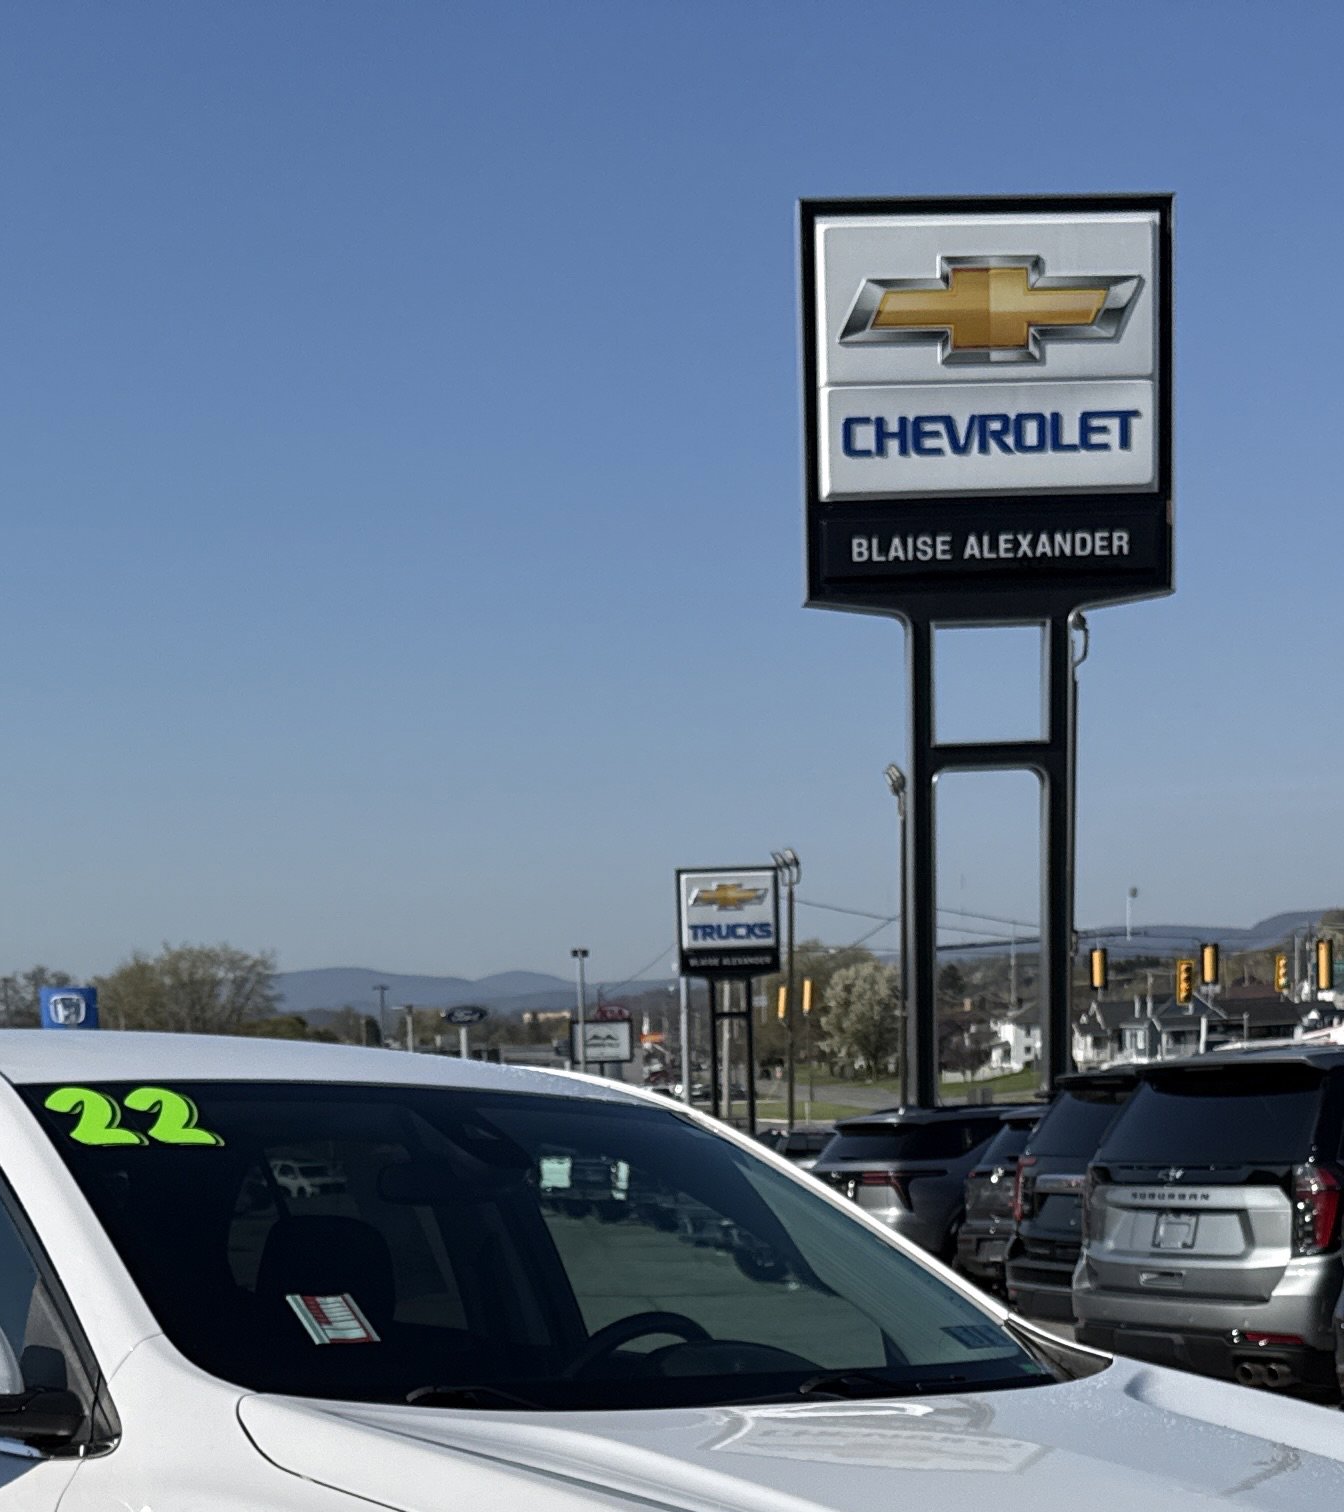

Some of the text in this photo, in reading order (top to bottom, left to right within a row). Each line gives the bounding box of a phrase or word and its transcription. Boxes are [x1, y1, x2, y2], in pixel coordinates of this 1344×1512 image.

[842, 410, 1142, 459] CHEVROLET
[852, 529, 1131, 562] BLAISE ALEXANDER
[689, 922, 772, 941] TRUCKS
[44, 1087, 225, 1146] 22
[1130, 1191, 1211, 1201] SUBURBAN
